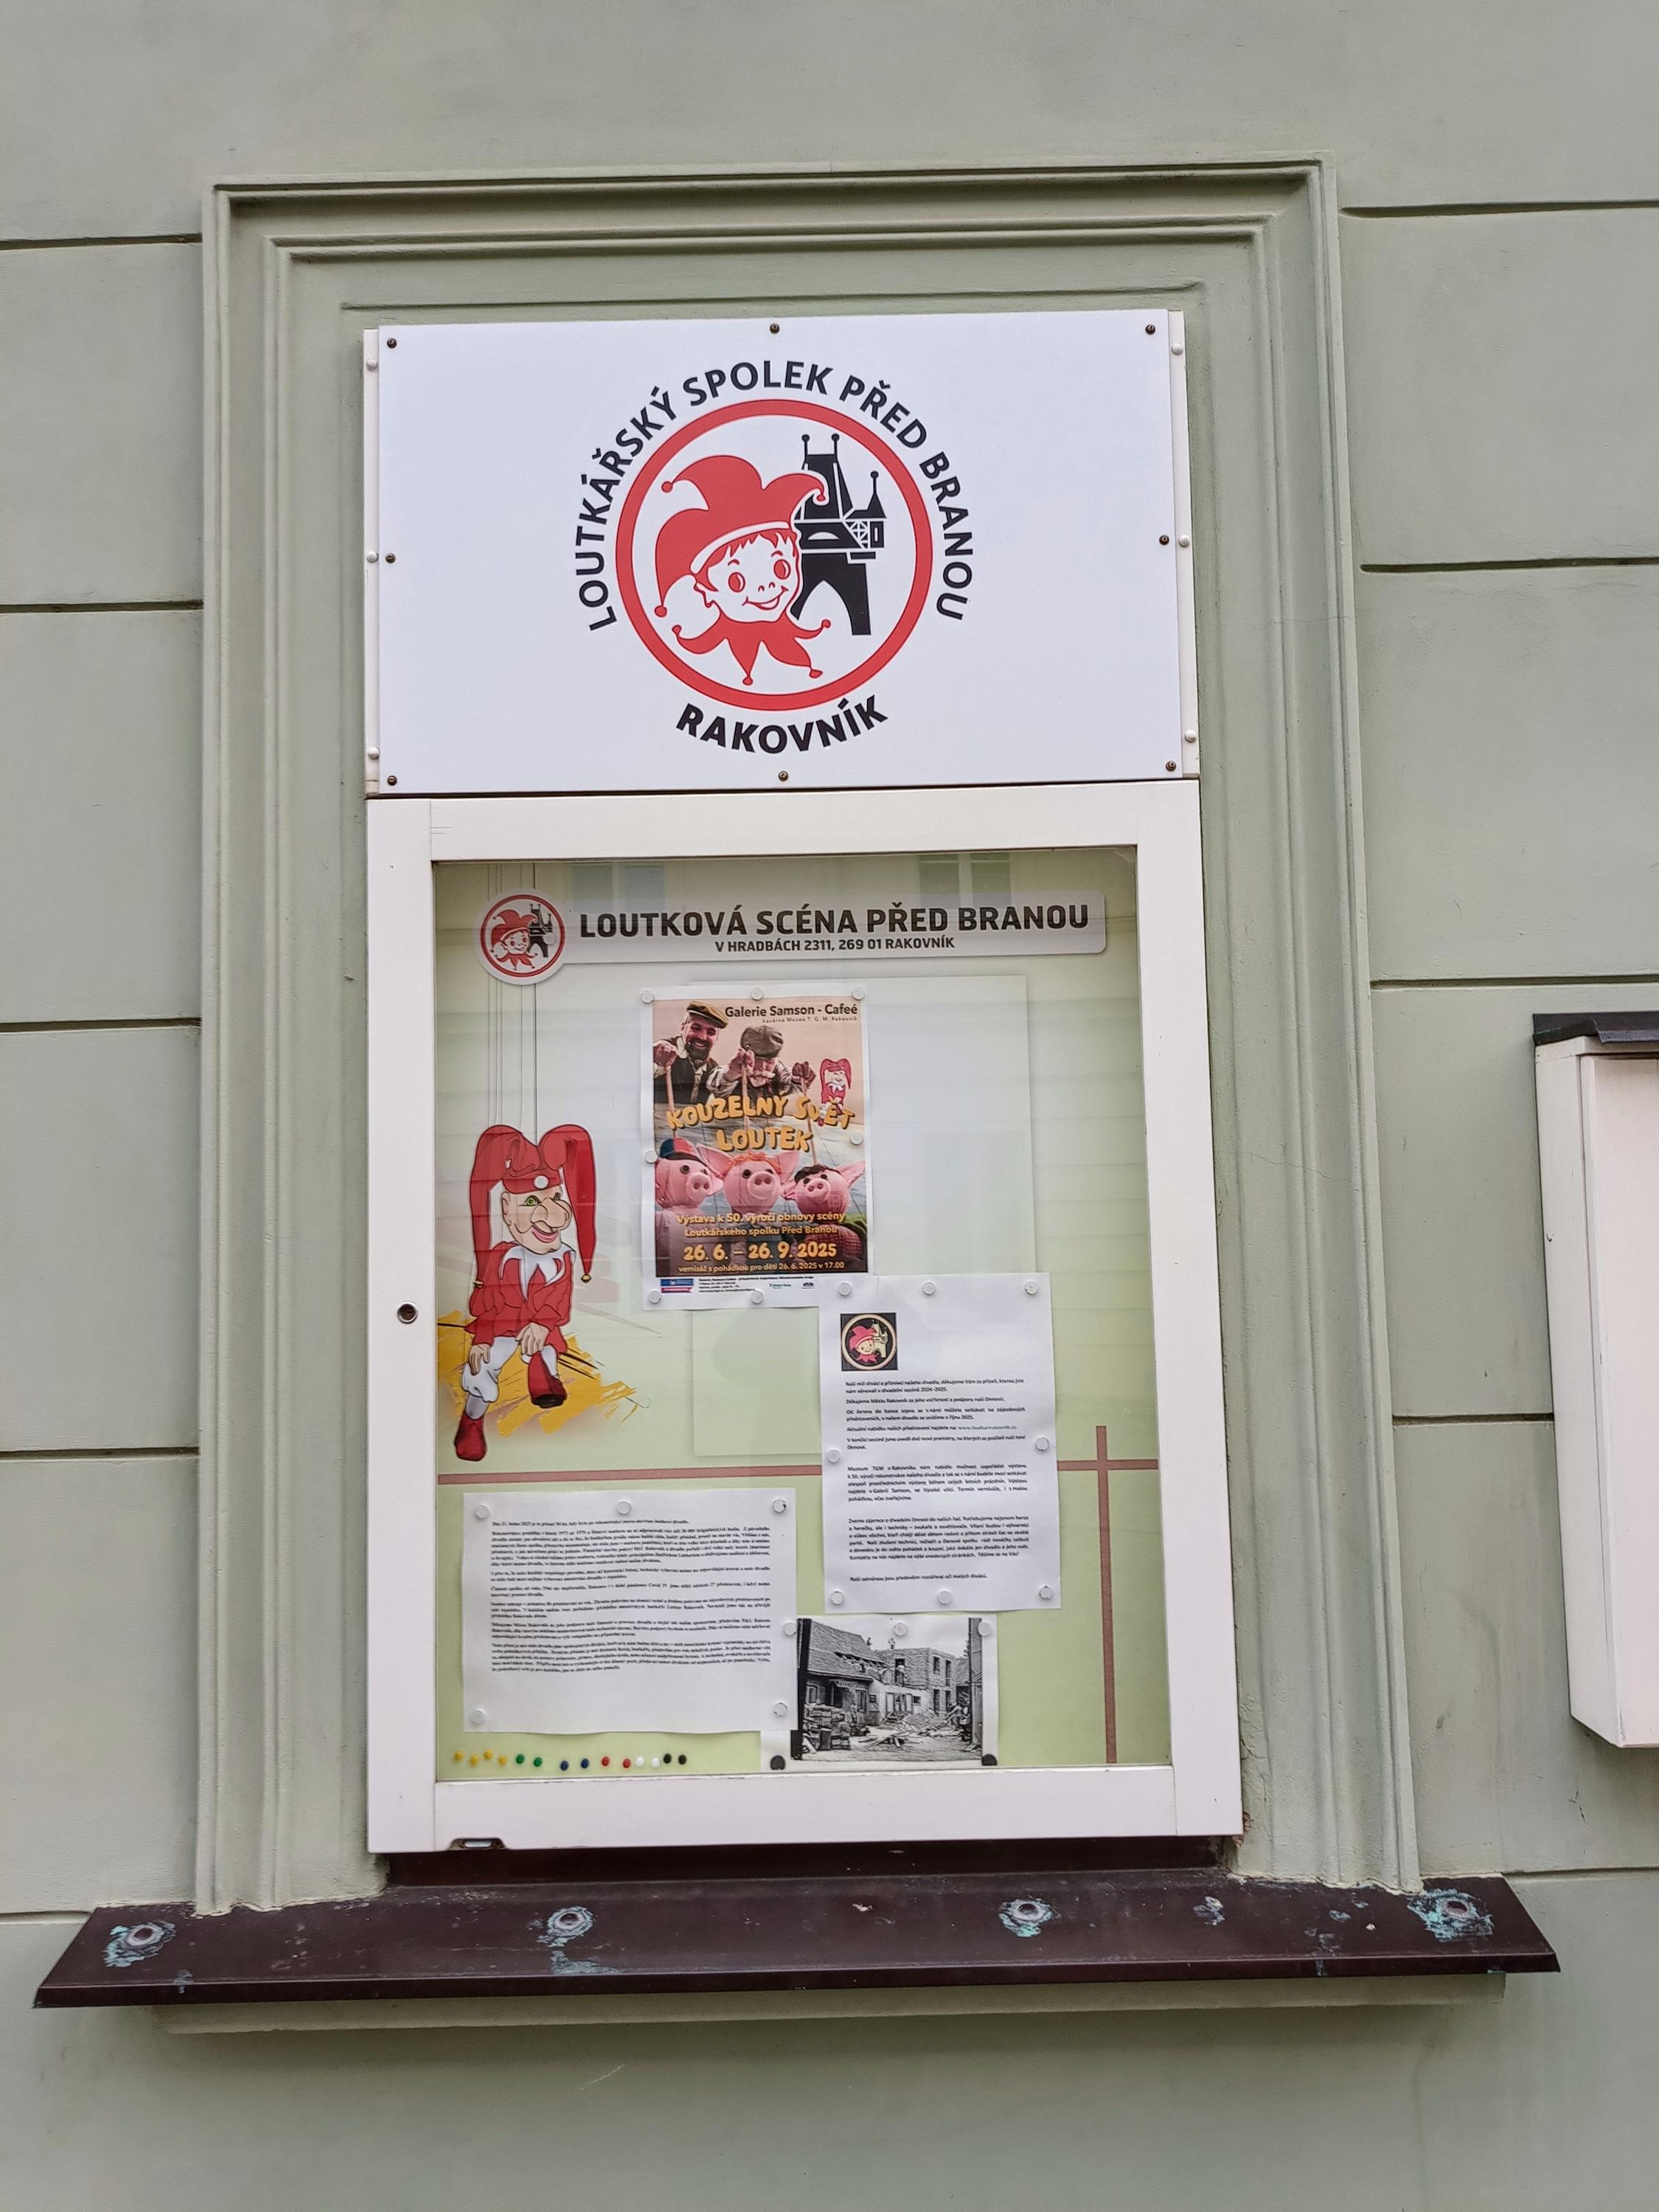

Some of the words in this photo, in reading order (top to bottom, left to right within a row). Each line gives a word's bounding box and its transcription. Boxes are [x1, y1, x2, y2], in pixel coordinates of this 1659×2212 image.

[575, 386, 678, 631] LOUTKÁŘSKÝ
[682, 360, 832, 406] SPOLEK
[838, 373, 928, 450] PŘED
[919, 451, 973, 620] BRANOU
[675, 693, 888, 754] RAKOVNÍK
[580, 904, 746, 939] LOUTKOVÁ
[757, 902, 856, 936] SCÉNA
[867, 902, 947, 933] PŘED
[959, 904, 1089, 932] BRANOU
[715, 941, 723, 953] V
[728, 937, 801, 953] HRADBÁCH
[804, 939, 835, 953] 2311,
[839, 938, 863, 950] 269
[868, 938, 882, 950] 01
[886, 935, 955, 950] RAKOVNÍK
[725, 1006, 767, 1017] Galerie
[770, 1006, 815, 1016] Samson
[825, 1003, 858, 1015] Cafeé
[666, 1092, 789, 1130] KOUZELNÝ
[793, 1096, 855, 1129] SVĚT
[716, 1126, 813, 1152] LOUTEK
[677, 1214, 716, 1225] Výstava
[718, 1214, 725, 1222] k
[726, 1214, 743, 1223] 50.
[745, 1213, 776, 1223] výročí
[778, 1213, 815, 1223] obnovy
[817, 1212, 846, 1222] scény
[684, 1228, 747, 1237] Loutkářského
[748, 1227, 779, 1237] spolku
[782, 1226, 803, 1235] Před
[684, 1245, 710, 1261] 26.
[713, 1244, 728, 1260] 6.
[748, 1242, 773, 1259] 26.
[777, 1241, 793, 1259] 9.
[797, 1241, 838, 1258] 2025
[678, 1263, 708, 1273] vernisáž
[714, 1262, 748, 1273] pohádkou
[750, 1264, 762, 1272] pro
[799, 1262, 817, 1270] 2025
